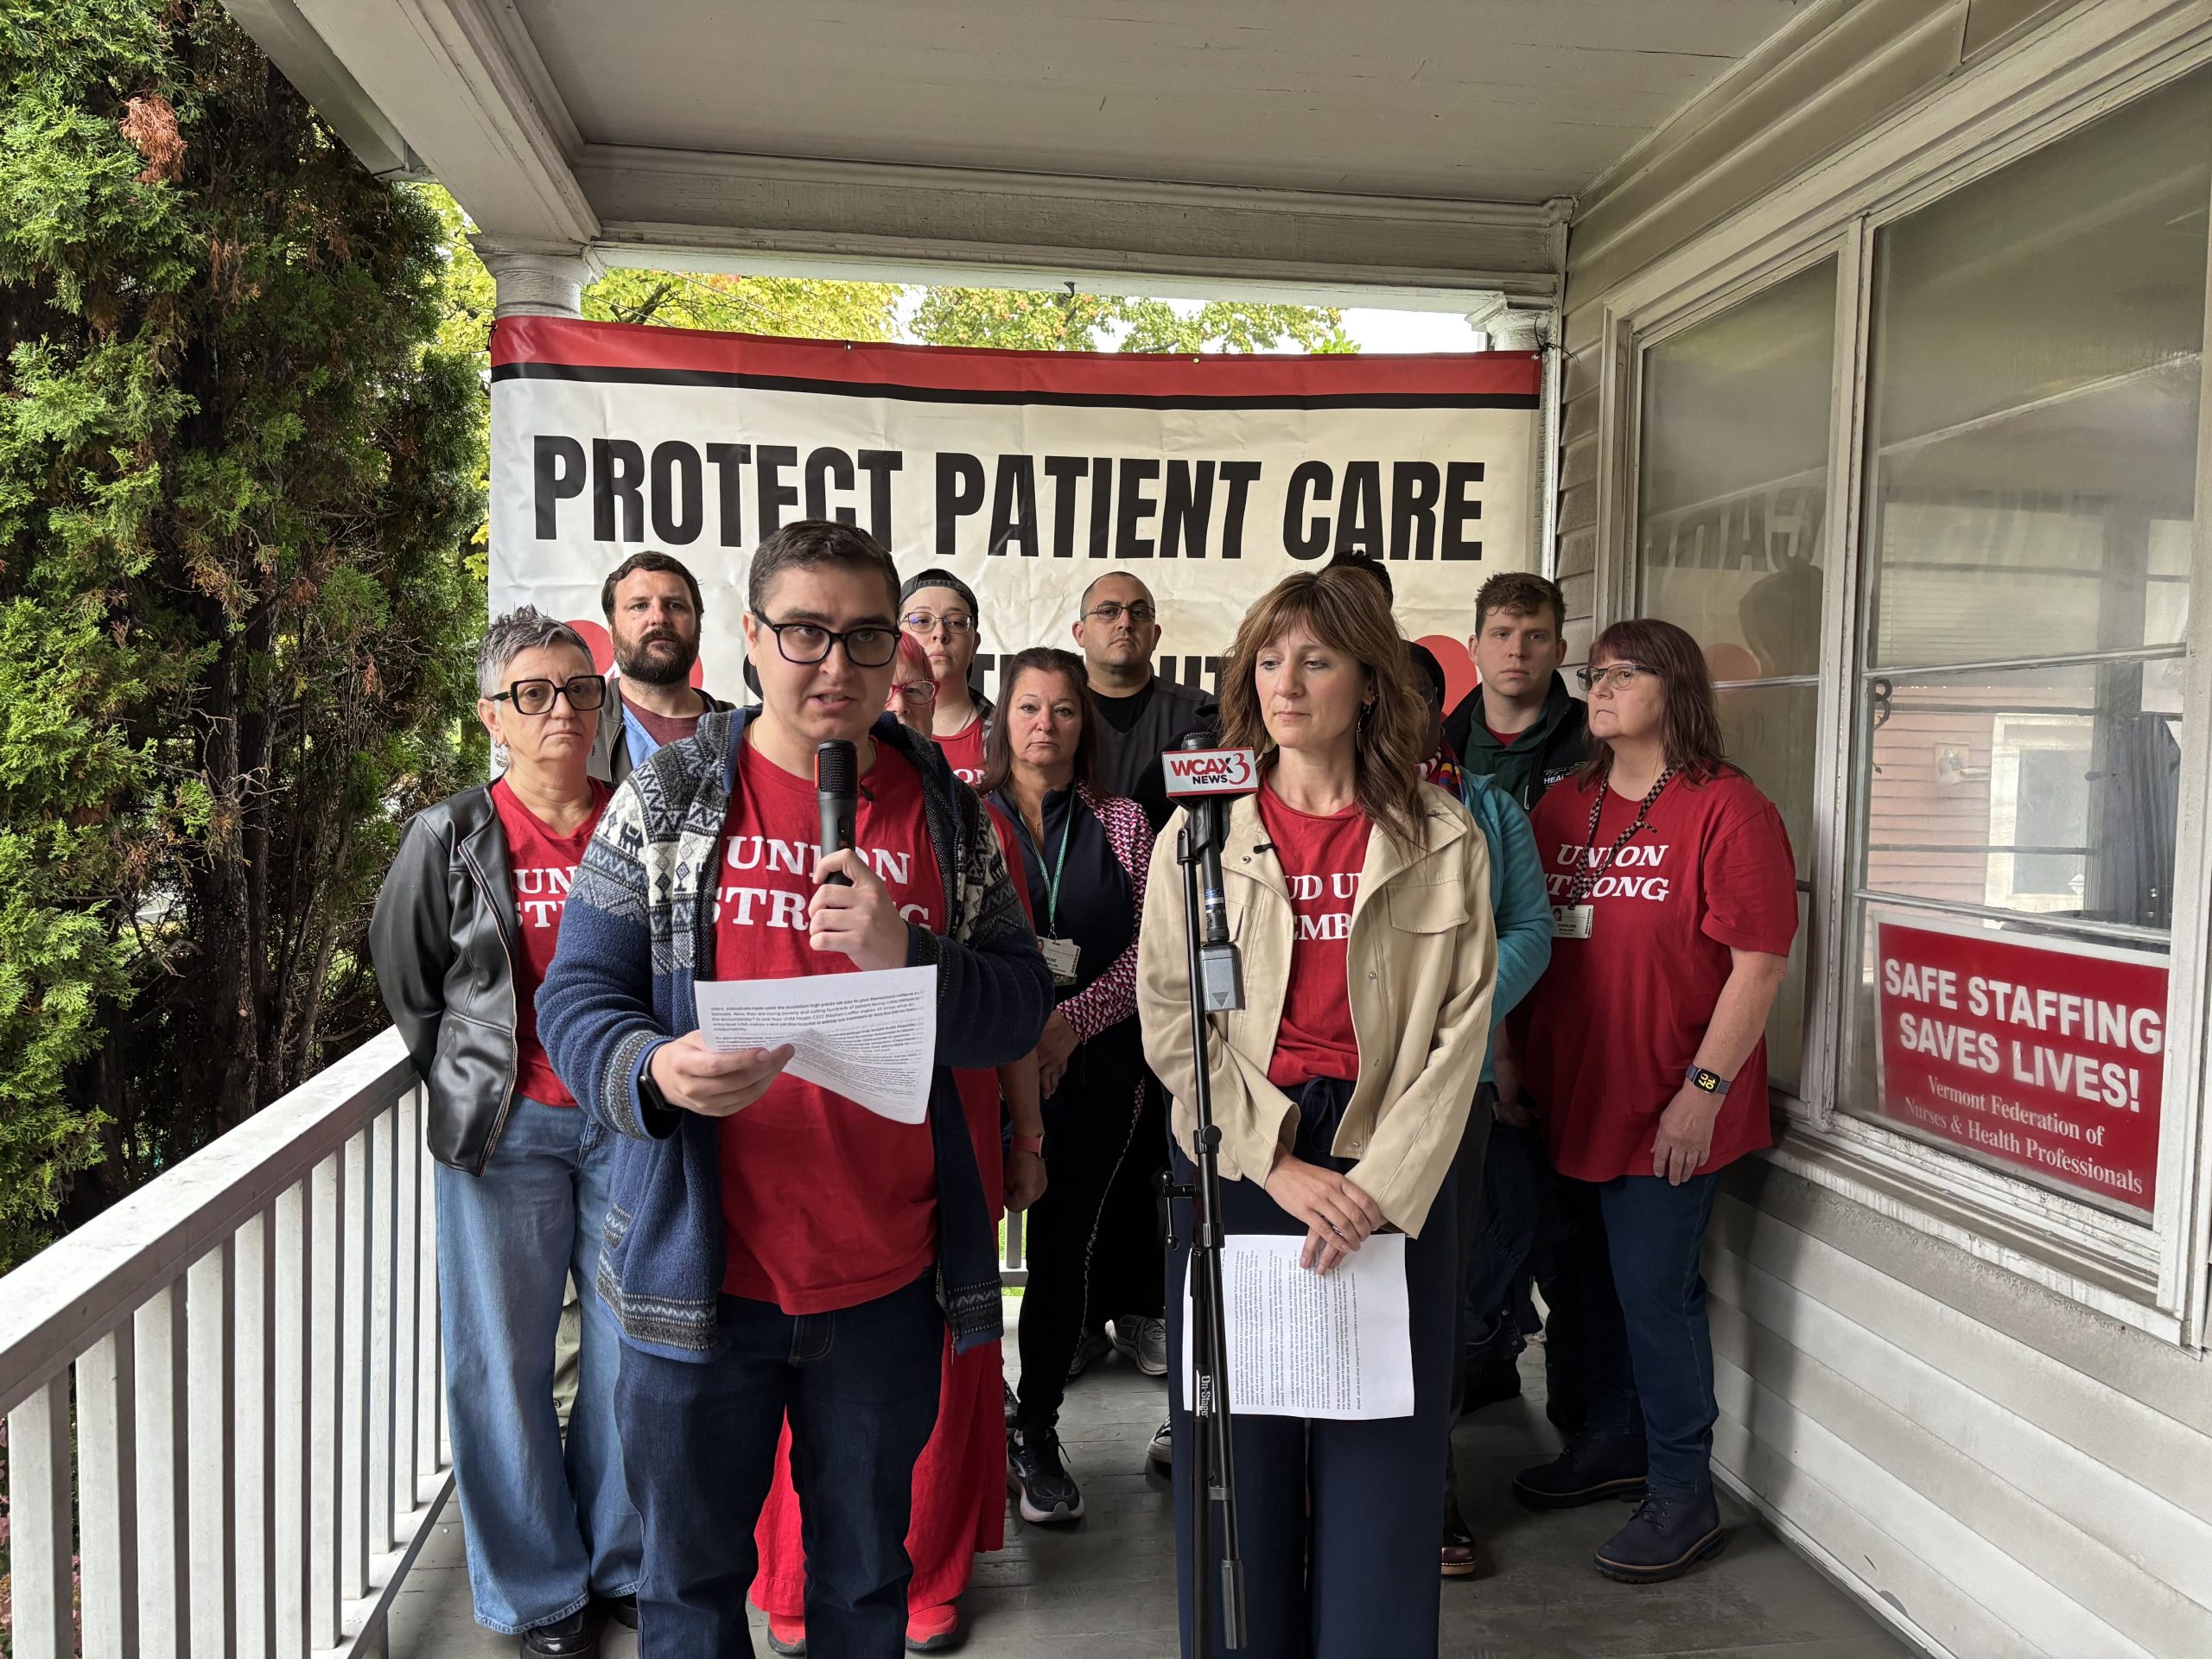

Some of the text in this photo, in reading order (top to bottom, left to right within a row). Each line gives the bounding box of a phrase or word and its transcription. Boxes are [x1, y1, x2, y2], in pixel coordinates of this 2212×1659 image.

[534, 435, 1484, 561] PROTECT PATIENT CARE
[1192, 774, 1228, 785] NEWS
[1885, 958, 2163, 1054] SAFE STAFFING
[1899, 1012, 2140, 1113] SAVES LIVES!
[1927, 1074, 2105, 1147] Vermont Federation of
[1904, 1096, 2144, 1195] Nurses & Health Professionals
[1199, 1375, 1211, 1417] On-Stage
